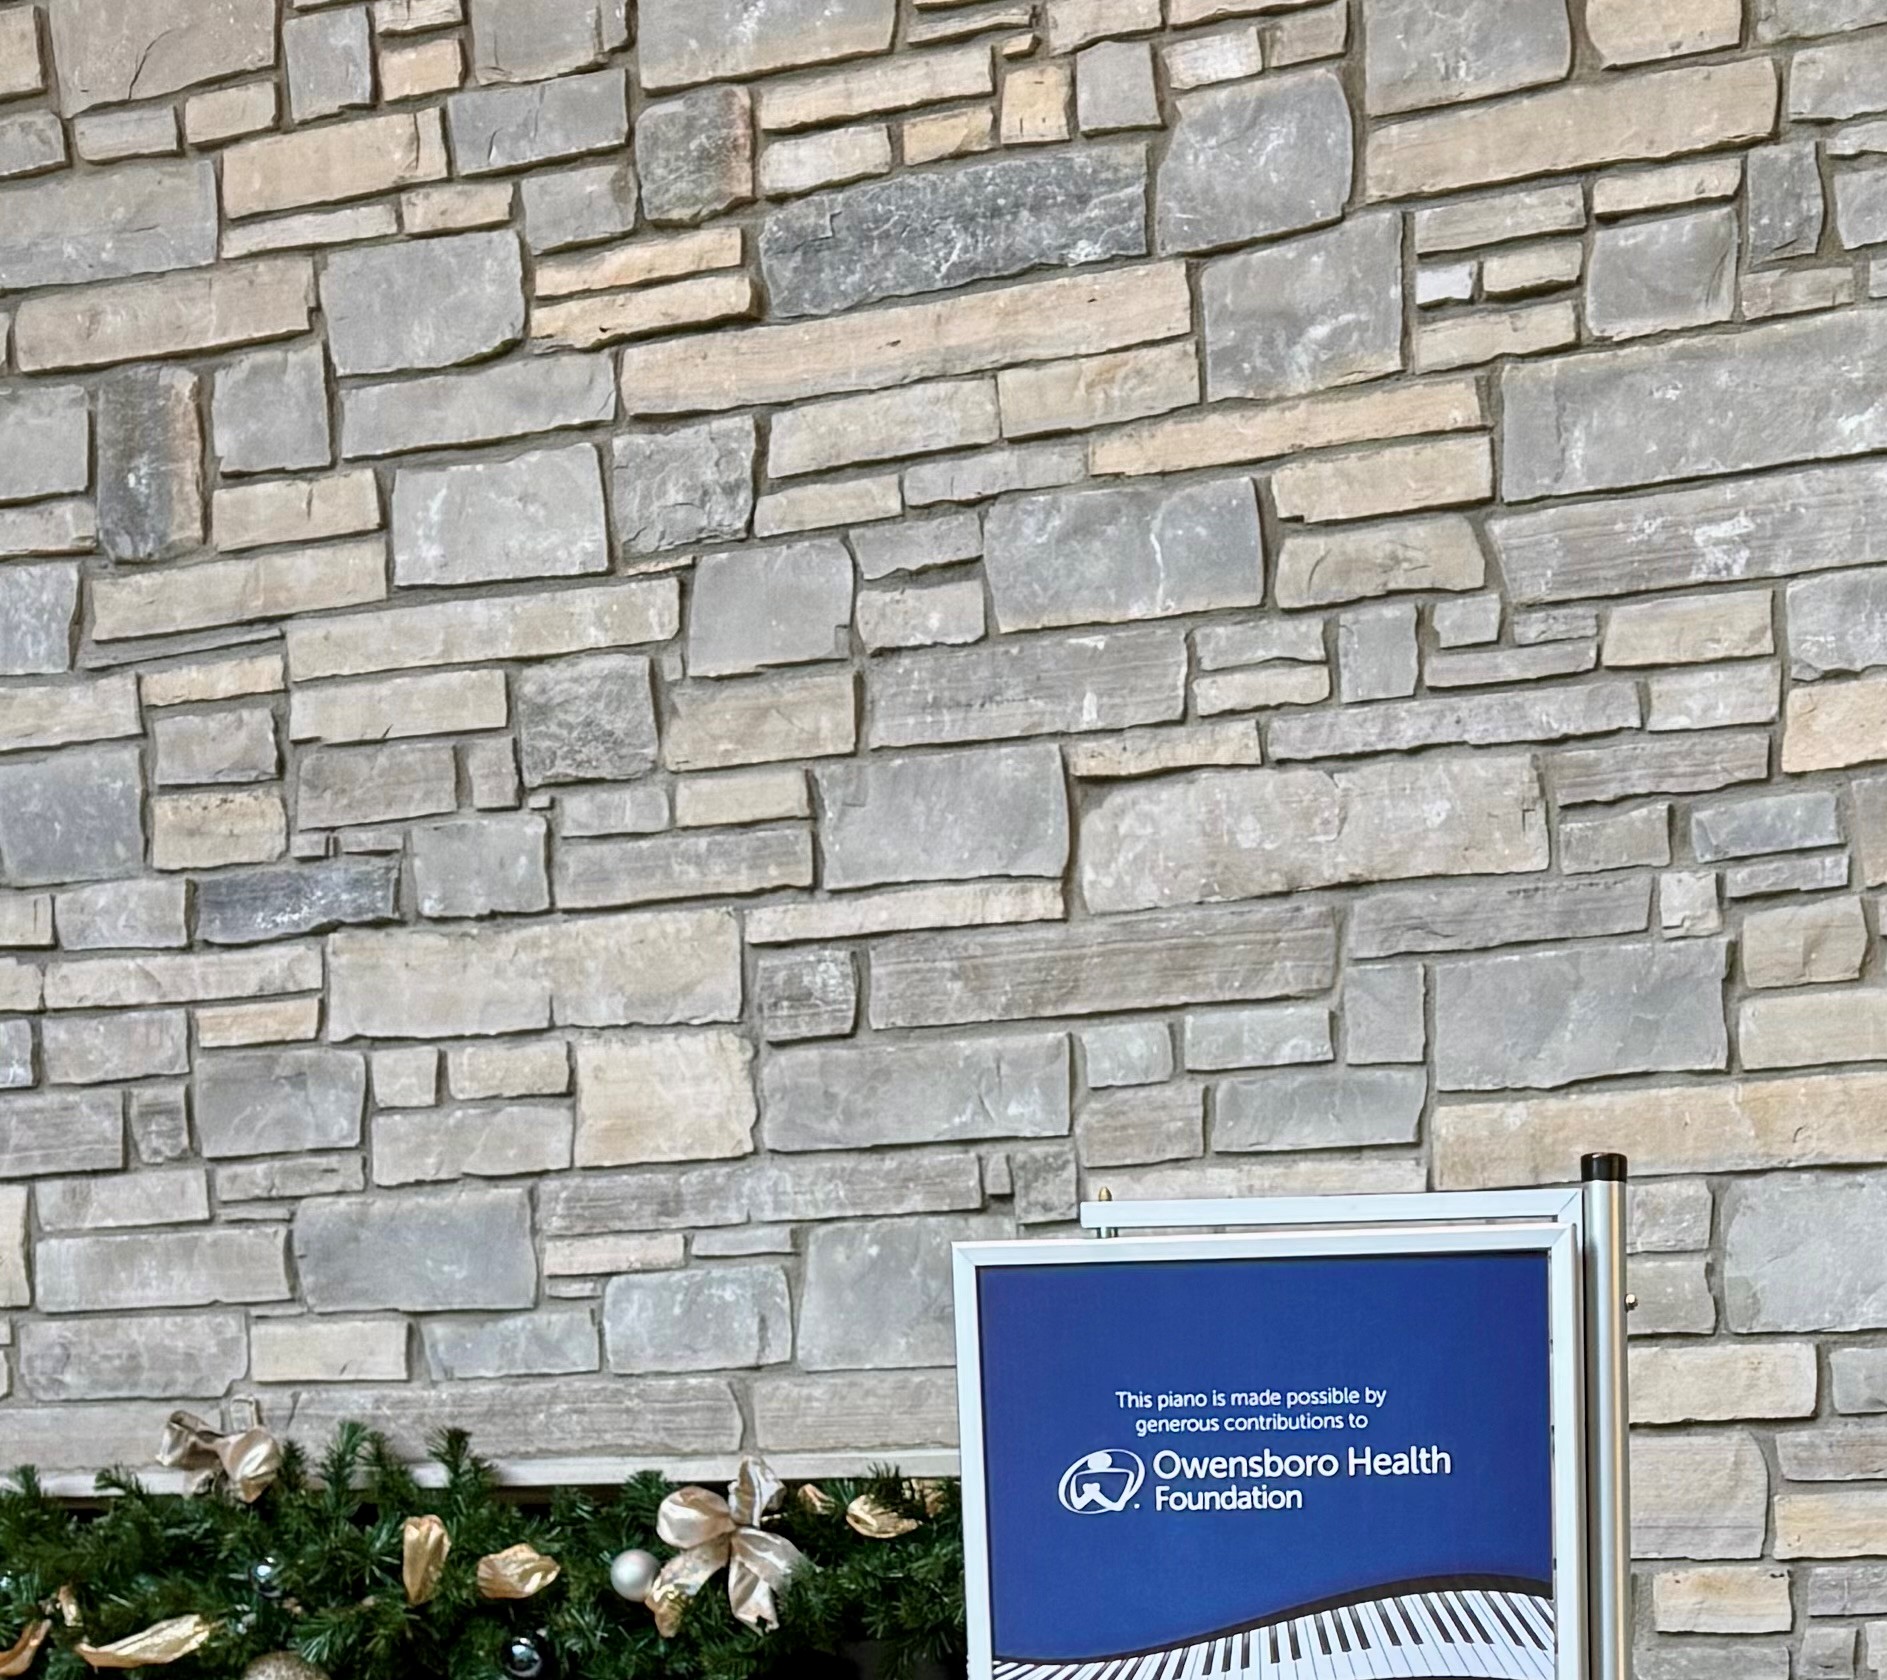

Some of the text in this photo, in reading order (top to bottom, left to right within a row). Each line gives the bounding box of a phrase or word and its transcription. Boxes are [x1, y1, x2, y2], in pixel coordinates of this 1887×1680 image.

[1116, 1387, 1386, 1412] This piano is made possible by
[1135, 1412, 1368, 1437] generous contributions to
[1153, 1447, 1451, 1478] Owensboro Health
[1155, 1485, 1303, 1512] Foundation
